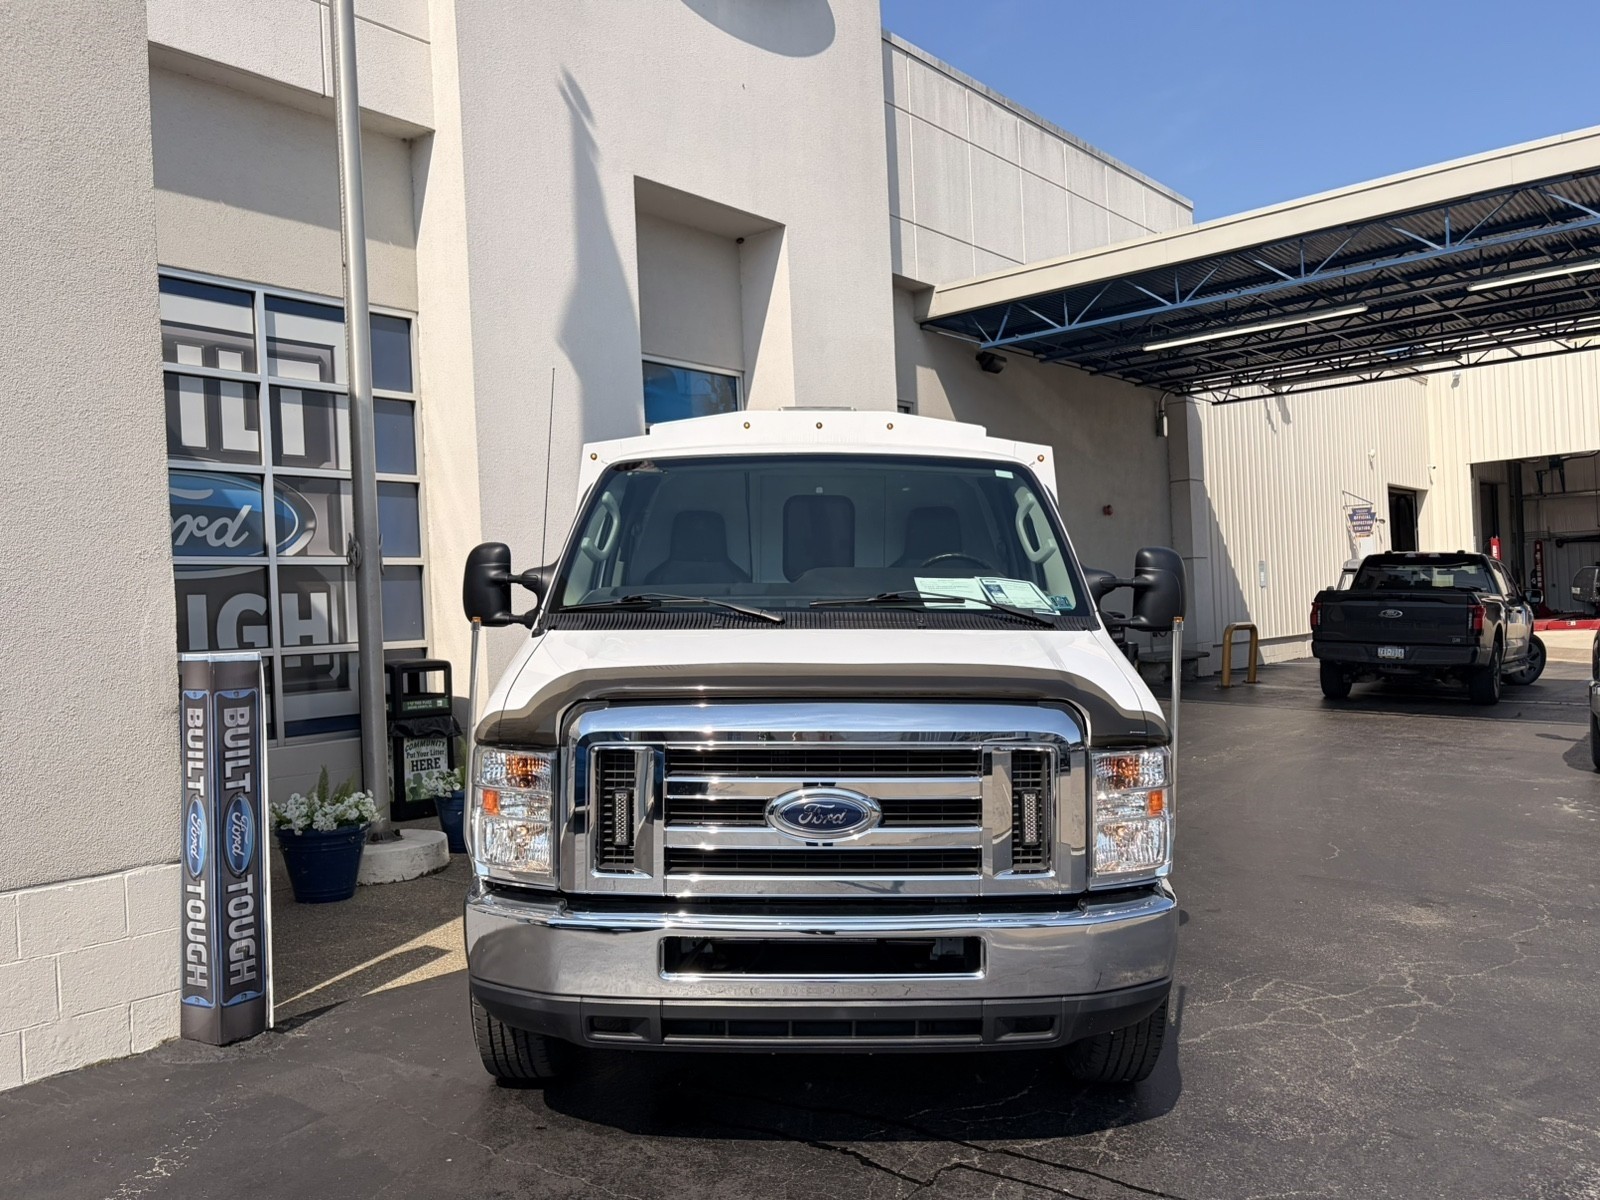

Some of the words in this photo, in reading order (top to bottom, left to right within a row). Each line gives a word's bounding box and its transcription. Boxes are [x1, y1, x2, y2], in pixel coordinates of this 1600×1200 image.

[187, 707, 205, 797] BUILT
[223, 706, 251, 793] BUILT
[405, 740, 446, 753] COMMUNITY
[410, 757, 441, 772] HERE
[430, 749, 445, 757] Litter
[190, 811, 204, 860] Ford
[231, 811, 249, 857] Ford
[797, 802, 848, 825] Ford
[186, 879, 208, 988] TOUGH
[227, 873, 257, 986] TOUGH
